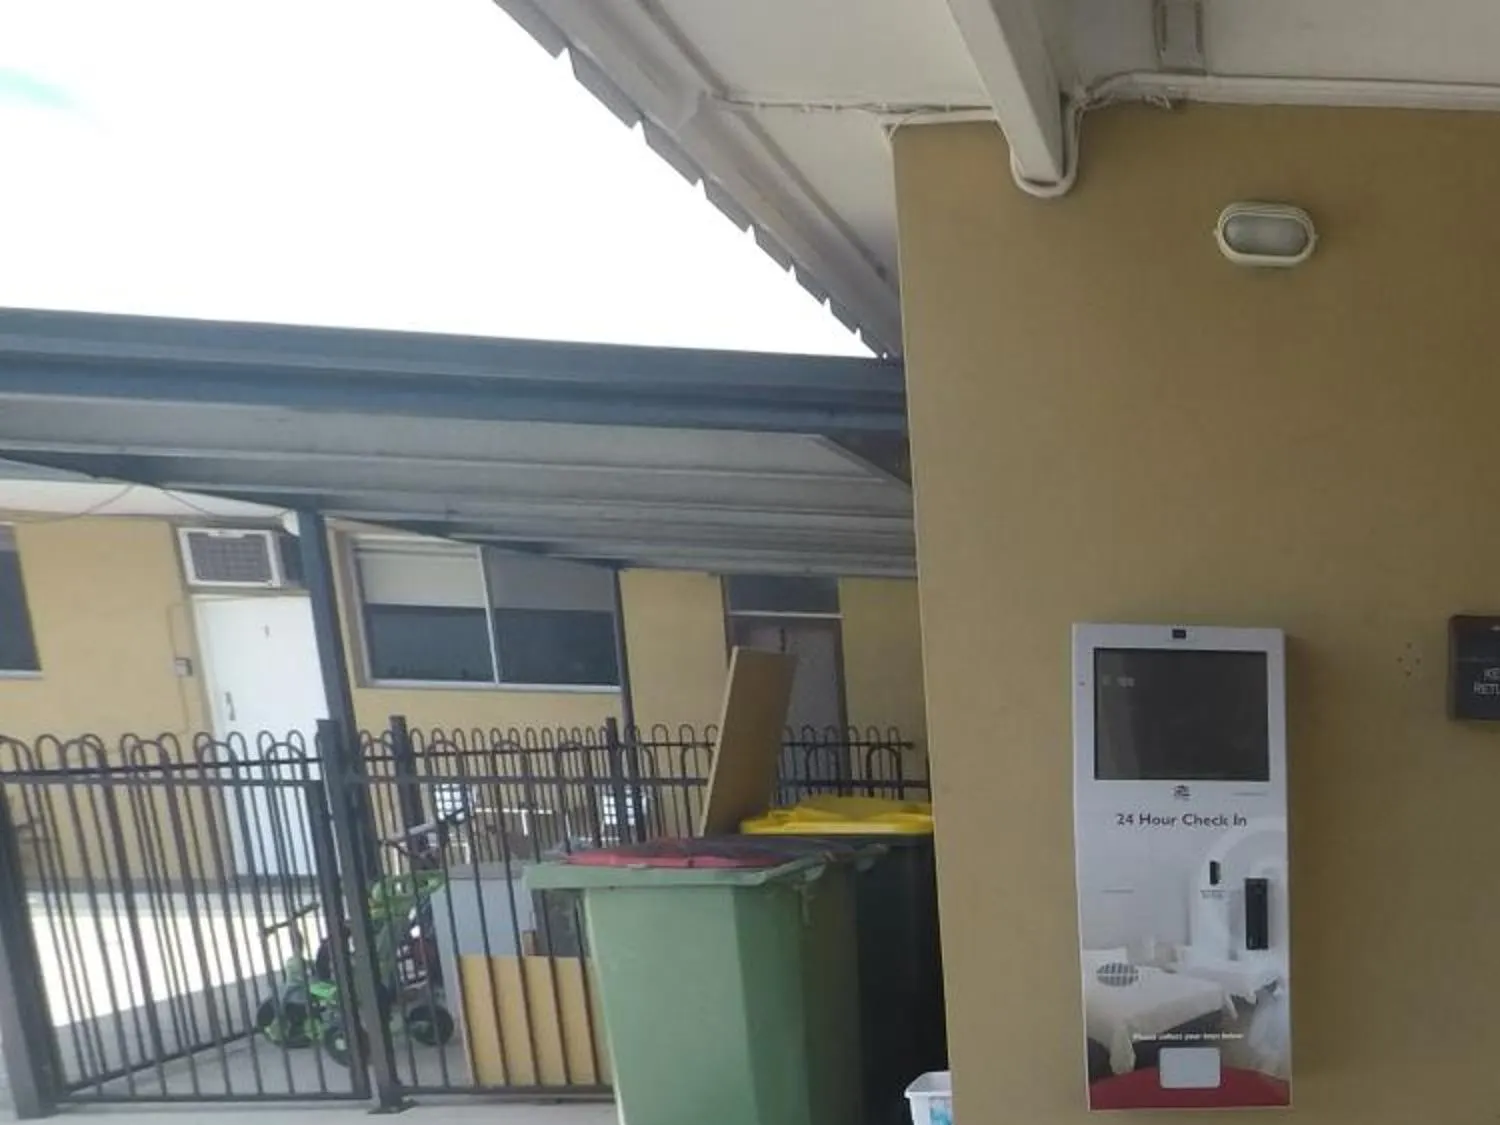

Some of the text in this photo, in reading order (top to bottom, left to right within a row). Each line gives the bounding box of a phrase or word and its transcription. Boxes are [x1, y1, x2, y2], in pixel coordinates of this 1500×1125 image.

[1116, 812, 1247, 827] 24 Hour Check In
